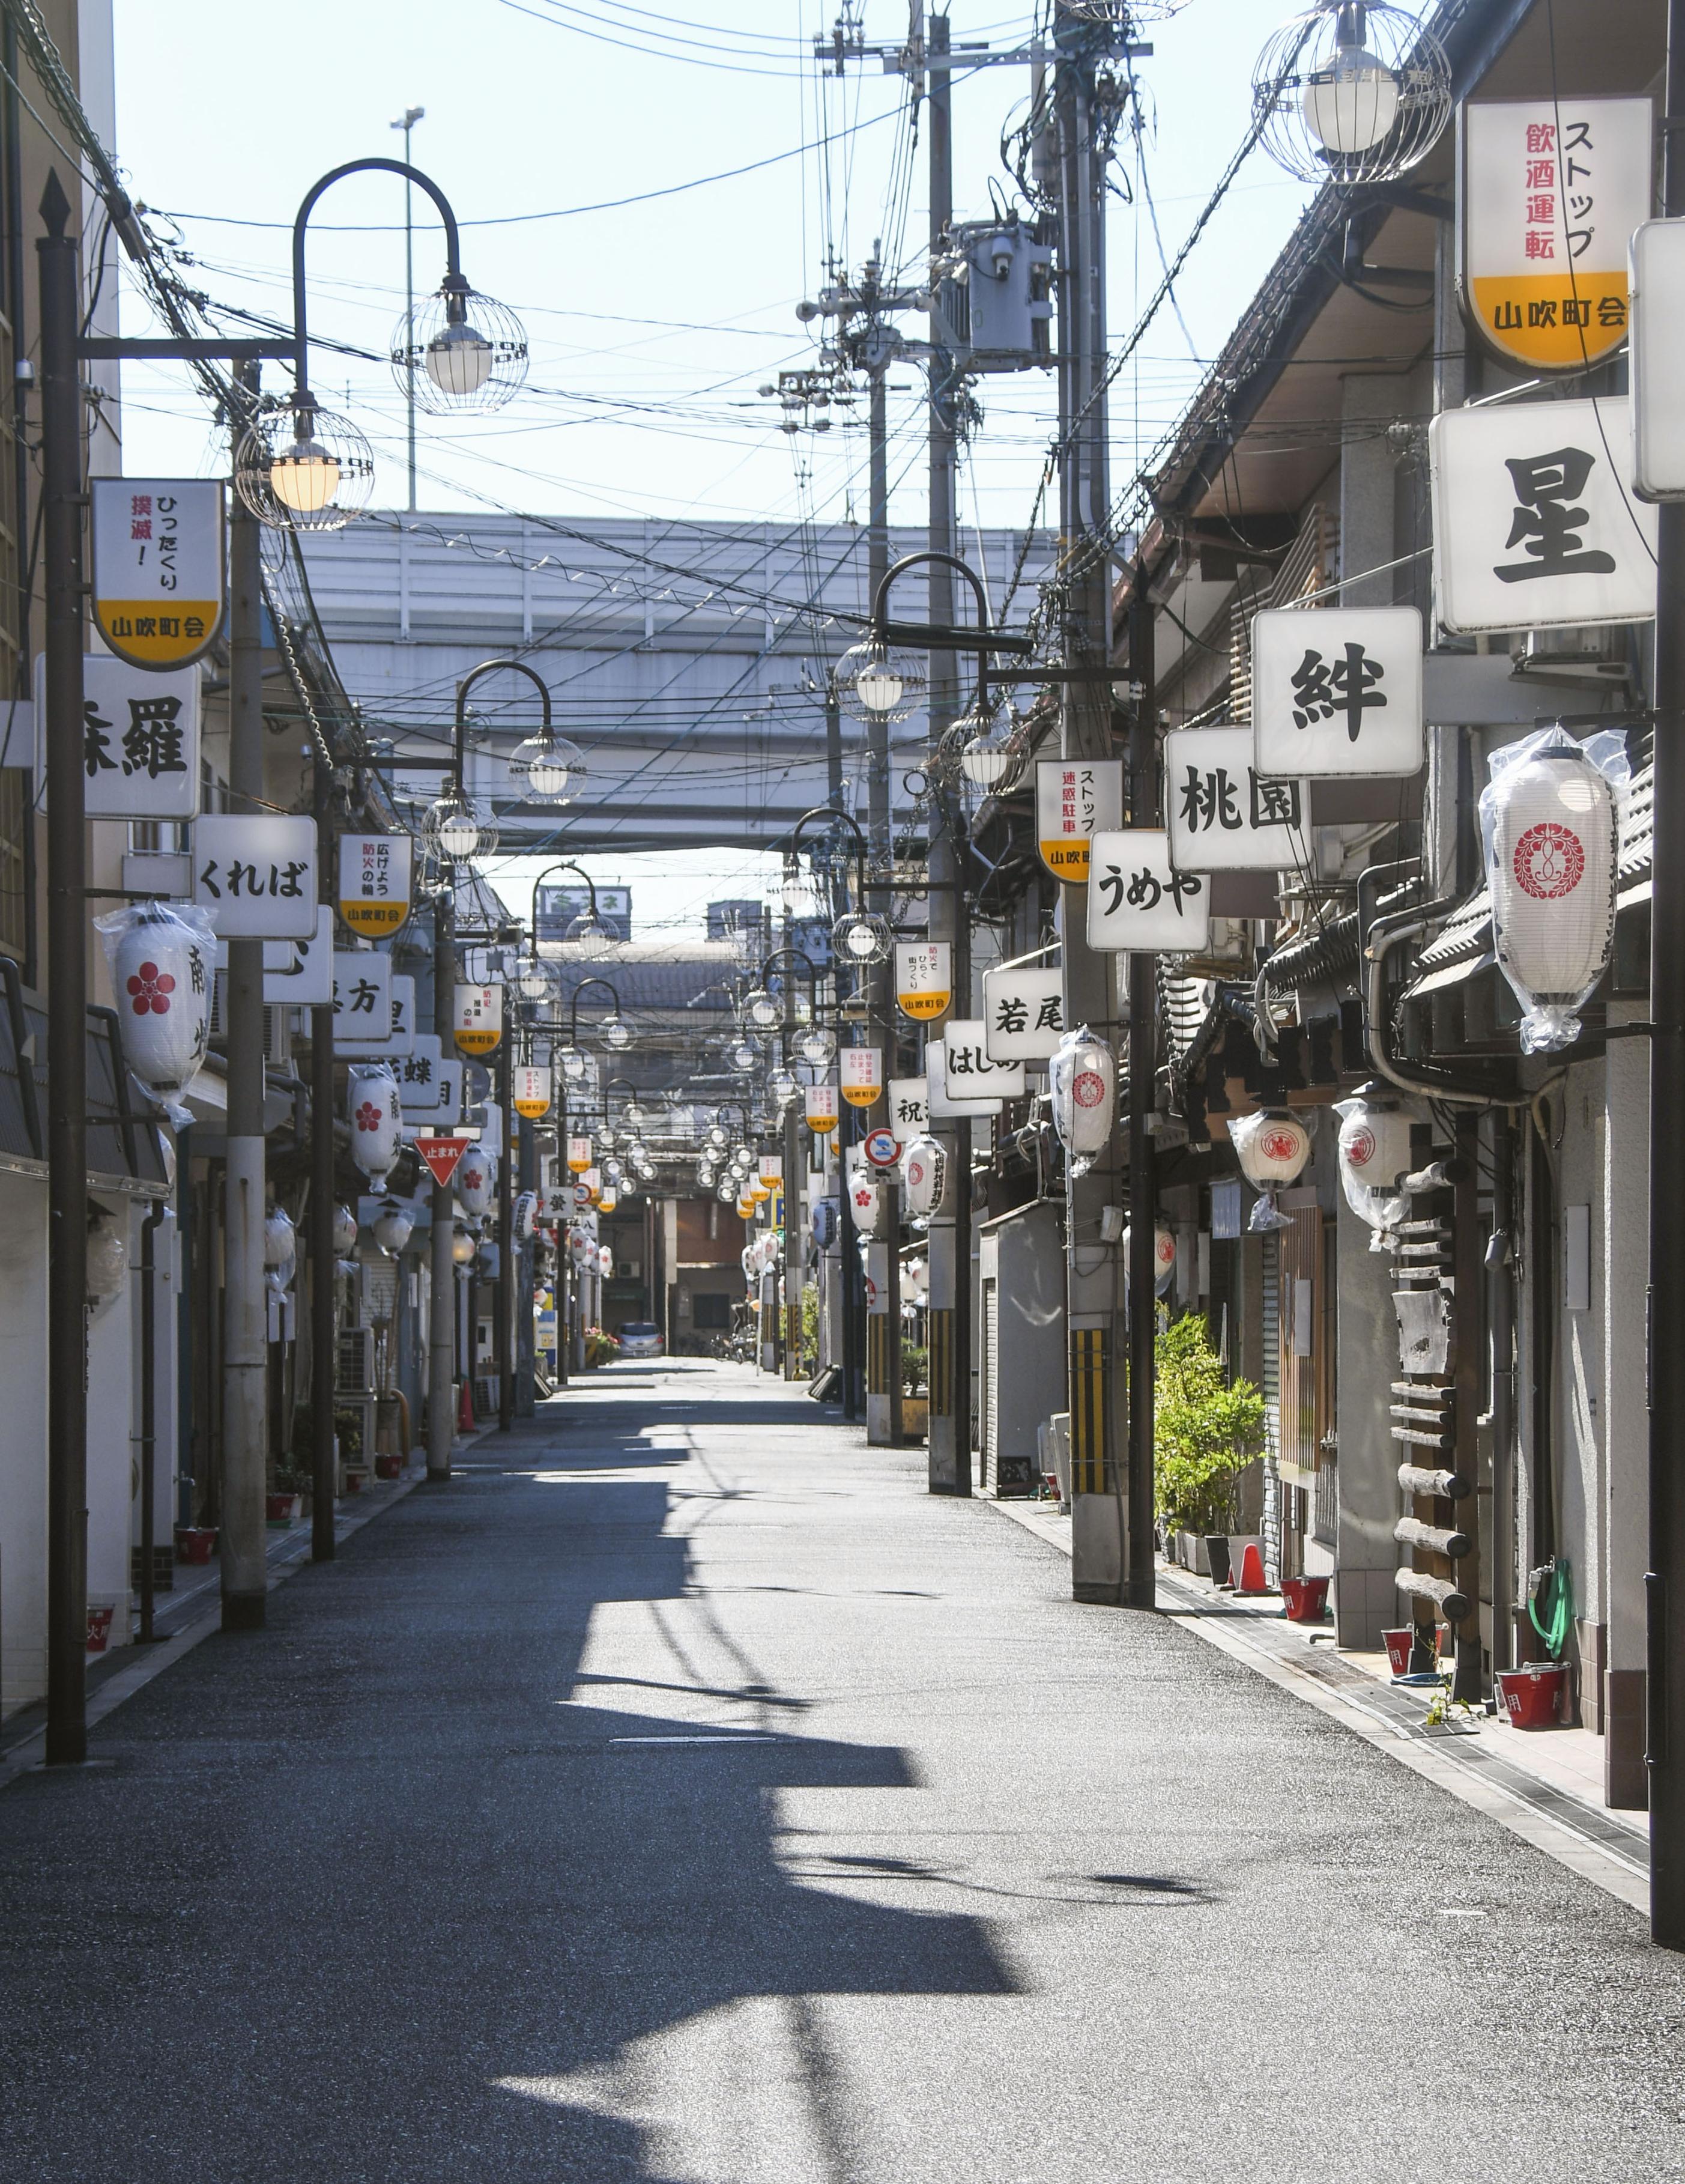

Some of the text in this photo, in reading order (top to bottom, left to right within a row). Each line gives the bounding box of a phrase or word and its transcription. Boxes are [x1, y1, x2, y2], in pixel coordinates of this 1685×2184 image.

[1525, 124, 1555, 259] 飲酒運転
[1564, 123, 1595, 258] ストップ
[1494, 297, 1626, 330] 山吹町会
[1493, 447, 1616, 583] 星
[157, 497, 177, 590] ひったくり
[112, 617, 205, 637] 山吹町会
[1291, 642, 1387, 742] 絆
[1062, 771, 1076, 833] 迷惑駐車
[1081, 770, 1095, 832] ストップ
[1179, 765, 1302, 833] 桃園
[201, 860, 309, 898] くれば
[362, 843, 375, 896] 防火の輪
[377, 843, 390, 896] 広げよう
[1099, 865, 1202, 917] うめや
[348, 908, 399, 921] 山吹町会
[929, 946, 937, 970] 防火で
[905, 998, 945, 1010] 山吹町会
[996, 995, 1063, 1034] 若尾
[426, 1147, 459, 1159] 止まれ
